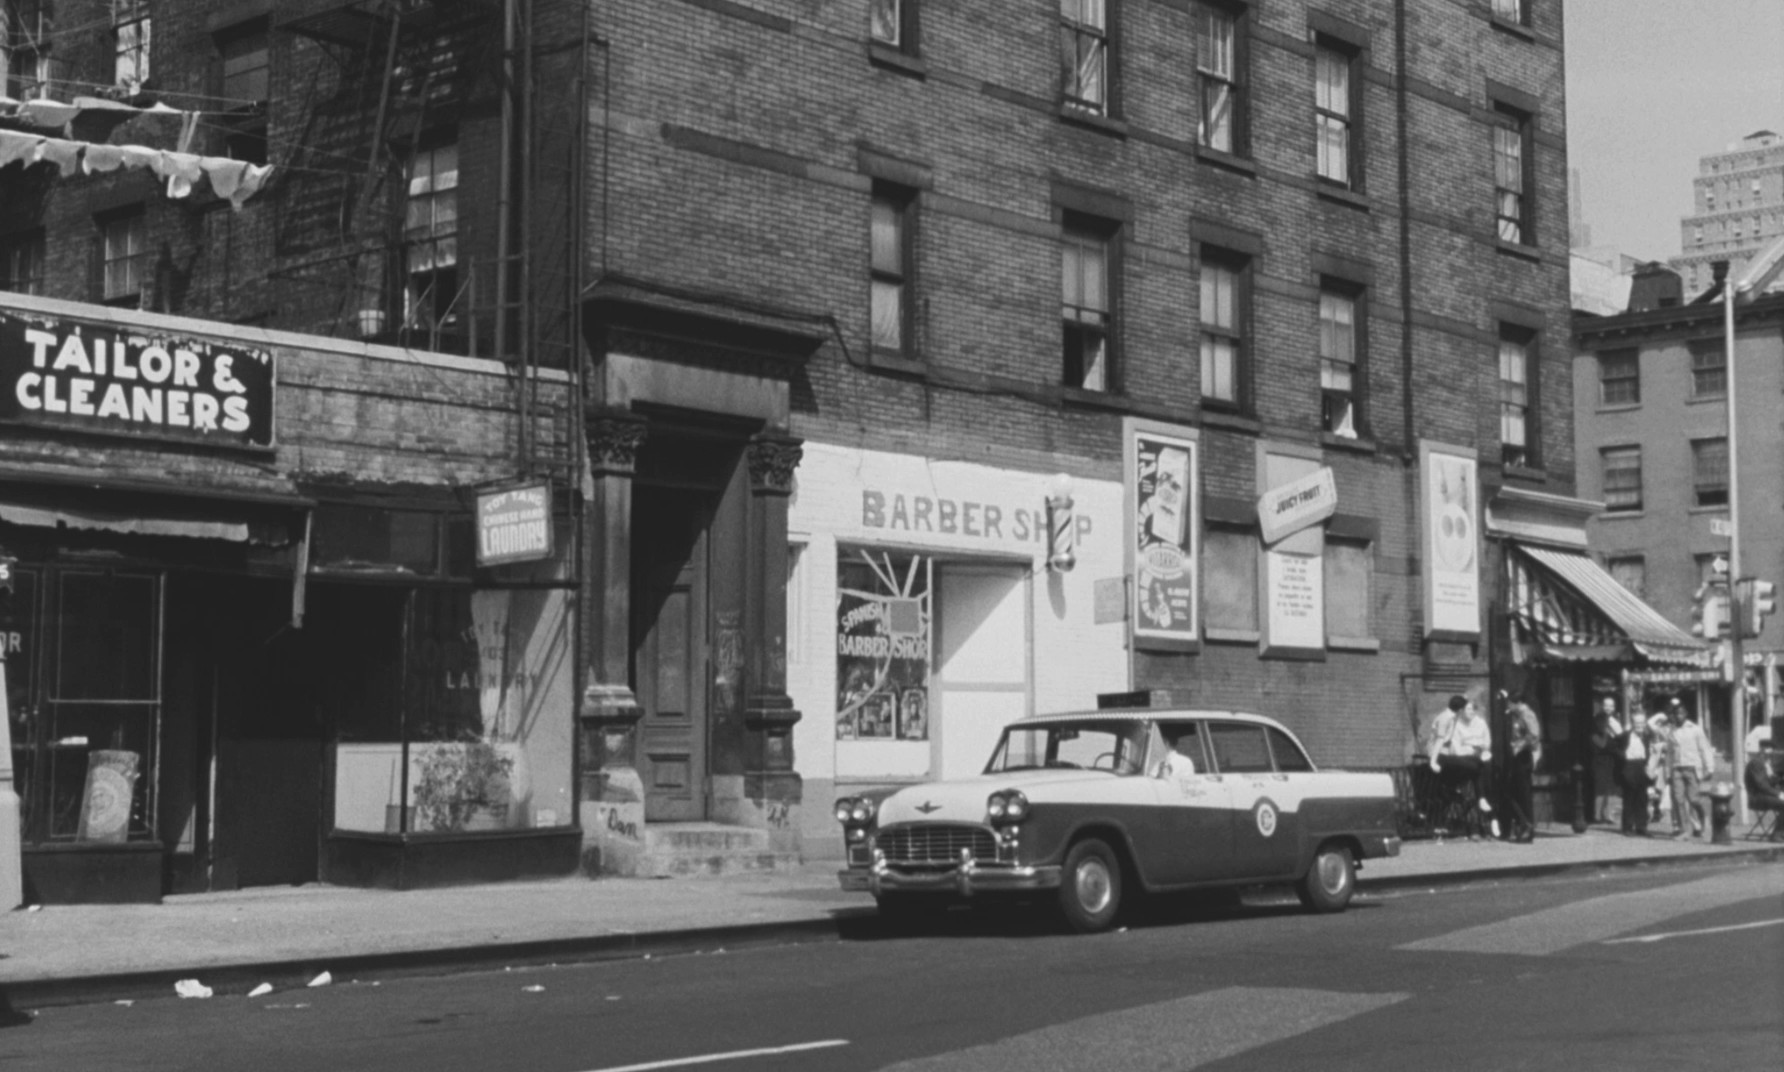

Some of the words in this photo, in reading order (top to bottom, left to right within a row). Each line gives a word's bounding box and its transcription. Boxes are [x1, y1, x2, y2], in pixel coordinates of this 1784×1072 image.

[24, 328, 200, 387] TAILOR
[213, 354, 247, 394] &
[16, 371, 251, 433] CLEANERS
[485, 493, 507, 512] TOY
[862, 489, 1003, 539] BARBER
[1011, 510, 1094, 547] SHP
[1276, 495, 1298, 515] JUICY
[1298, 484, 1321, 504] FRUIT
[482, 519, 547, 558] LAUNDRY
[839, 633, 889, 658] BARBER
[893, 637, 927, 661] SHOP
